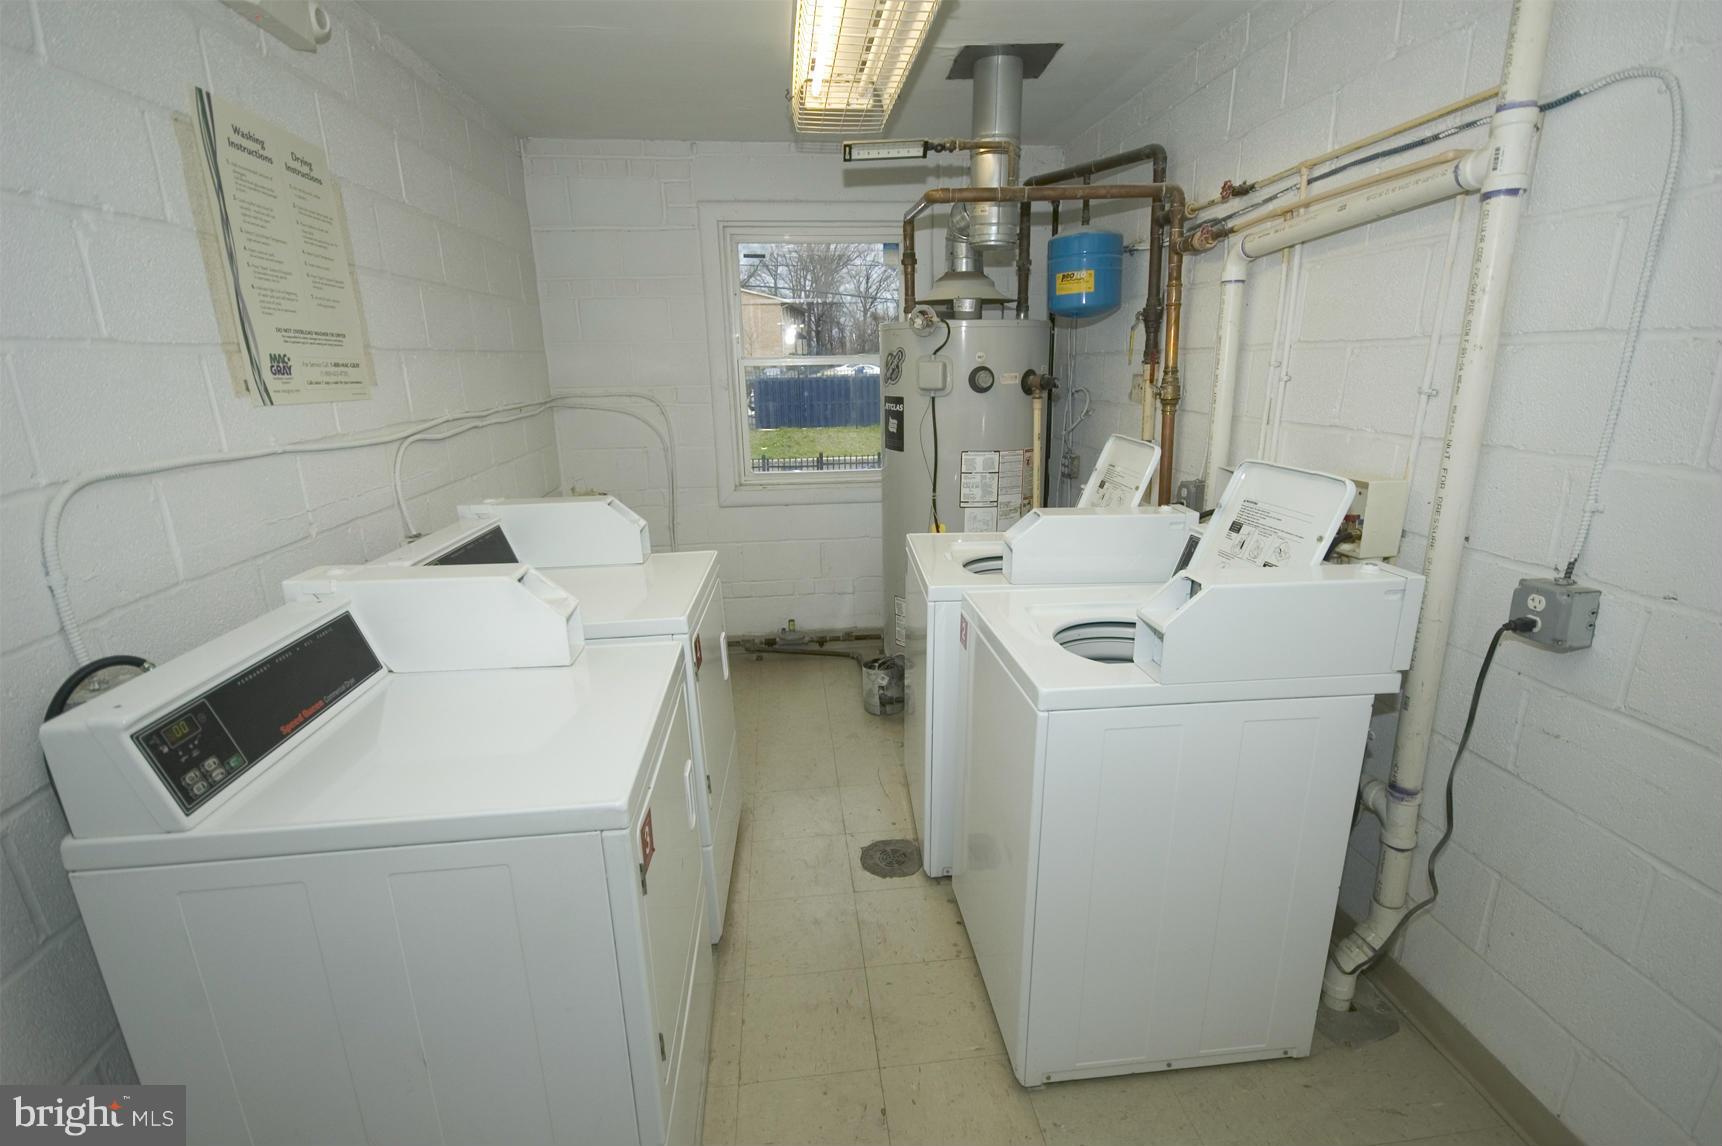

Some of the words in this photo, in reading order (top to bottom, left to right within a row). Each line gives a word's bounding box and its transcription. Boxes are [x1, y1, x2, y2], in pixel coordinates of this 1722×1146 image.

[231, 124, 266, 151] Washing
[227, 136, 274, 165] Instructions
[291, 151, 314, 172] Drying
[284, 162, 323, 185] Instructions
[269, 365, 292, 376] GRAY
[1444, 439, 1453, 460] NOT
[1439, 467, 1449, 489] FOR
[1430, 496, 1443, 550] PRESSURE
